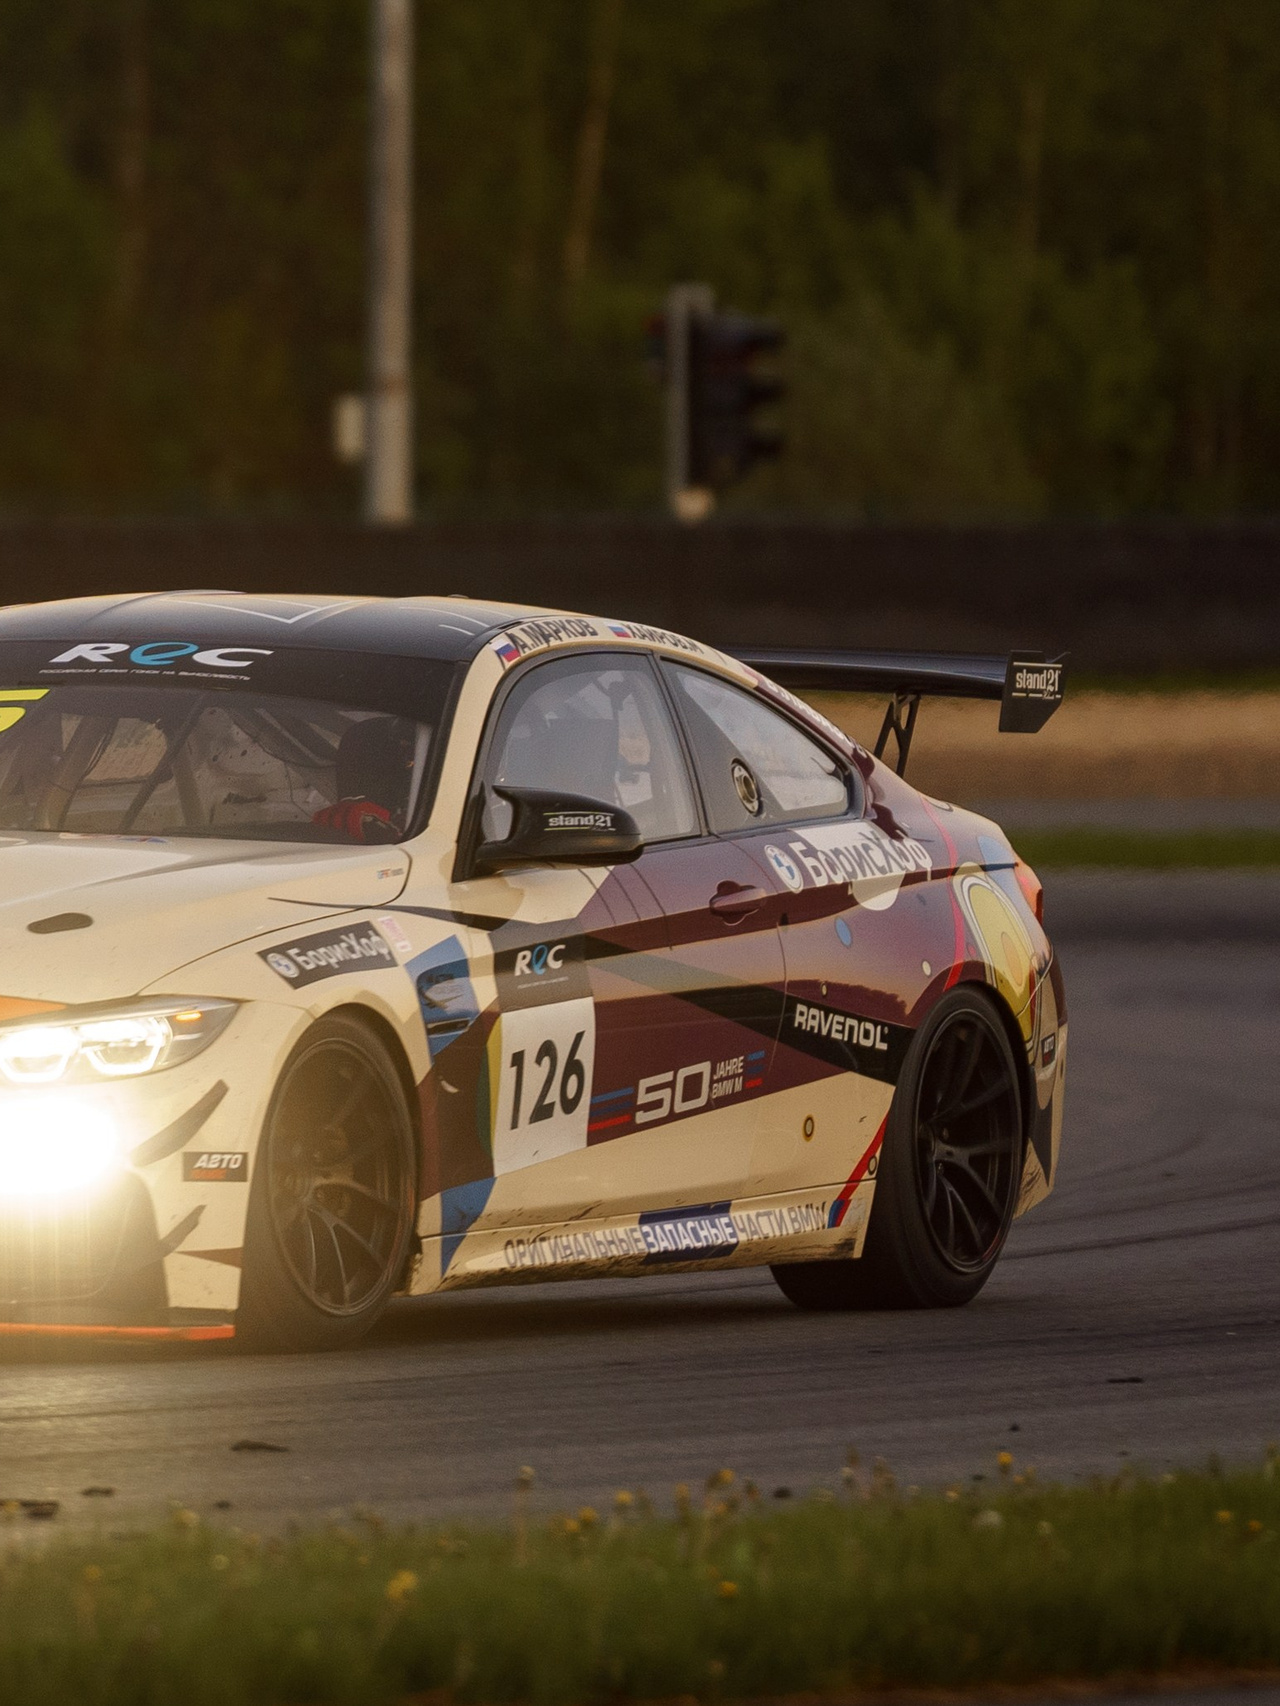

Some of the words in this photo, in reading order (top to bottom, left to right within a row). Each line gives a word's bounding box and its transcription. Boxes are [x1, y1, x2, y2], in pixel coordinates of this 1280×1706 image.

[1016, 668, 1060, 692] stand21
[548, 815, 613, 827] stand21
[788, 829, 933, 888] БорисХоф
[286, 930, 391, 971] БорисХоф
[794, 1003, 888, 1051] RAVENOL
[510, 1030, 586, 1130] 126
[712, 1078, 734, 1099] BMW
[734, 1075, 743, 1093] M
[713, 1055, 745, 1080] JAHRE
[635, 1061, 712, 1124] 50
[504, 1227, 644, 1269] ОРИГИНАЛЬНЫЕ
[641, 1215, 738, 1254] ЗАПАСНЫЕ
[732, 1208, 787, 1241] ЧАСТИ
[787, 1201, 827, 1235] BMW
